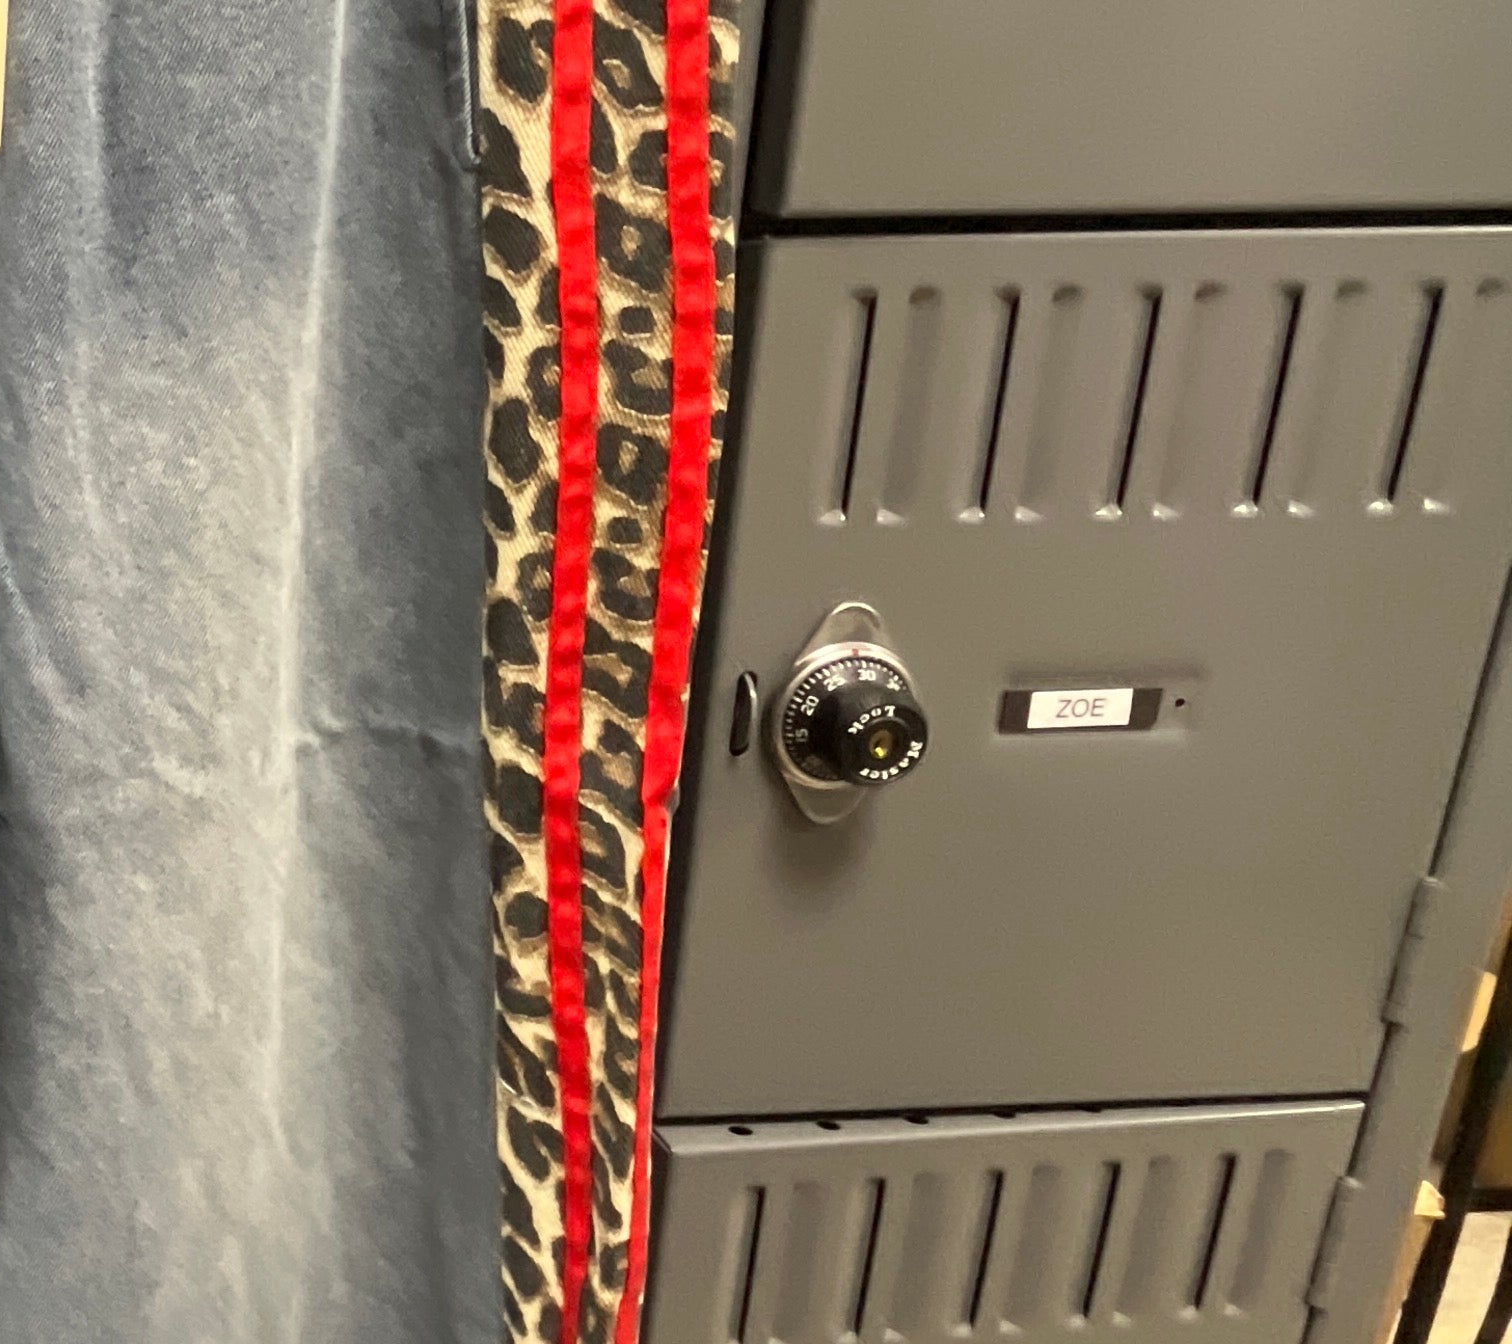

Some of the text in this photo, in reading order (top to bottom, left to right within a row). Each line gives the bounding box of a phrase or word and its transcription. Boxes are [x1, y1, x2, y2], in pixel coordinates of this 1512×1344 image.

[857, 669, 876, 681] 30
[800, 695, 820, 717] 20
[1055, 698, 1107, 719] ZOE
